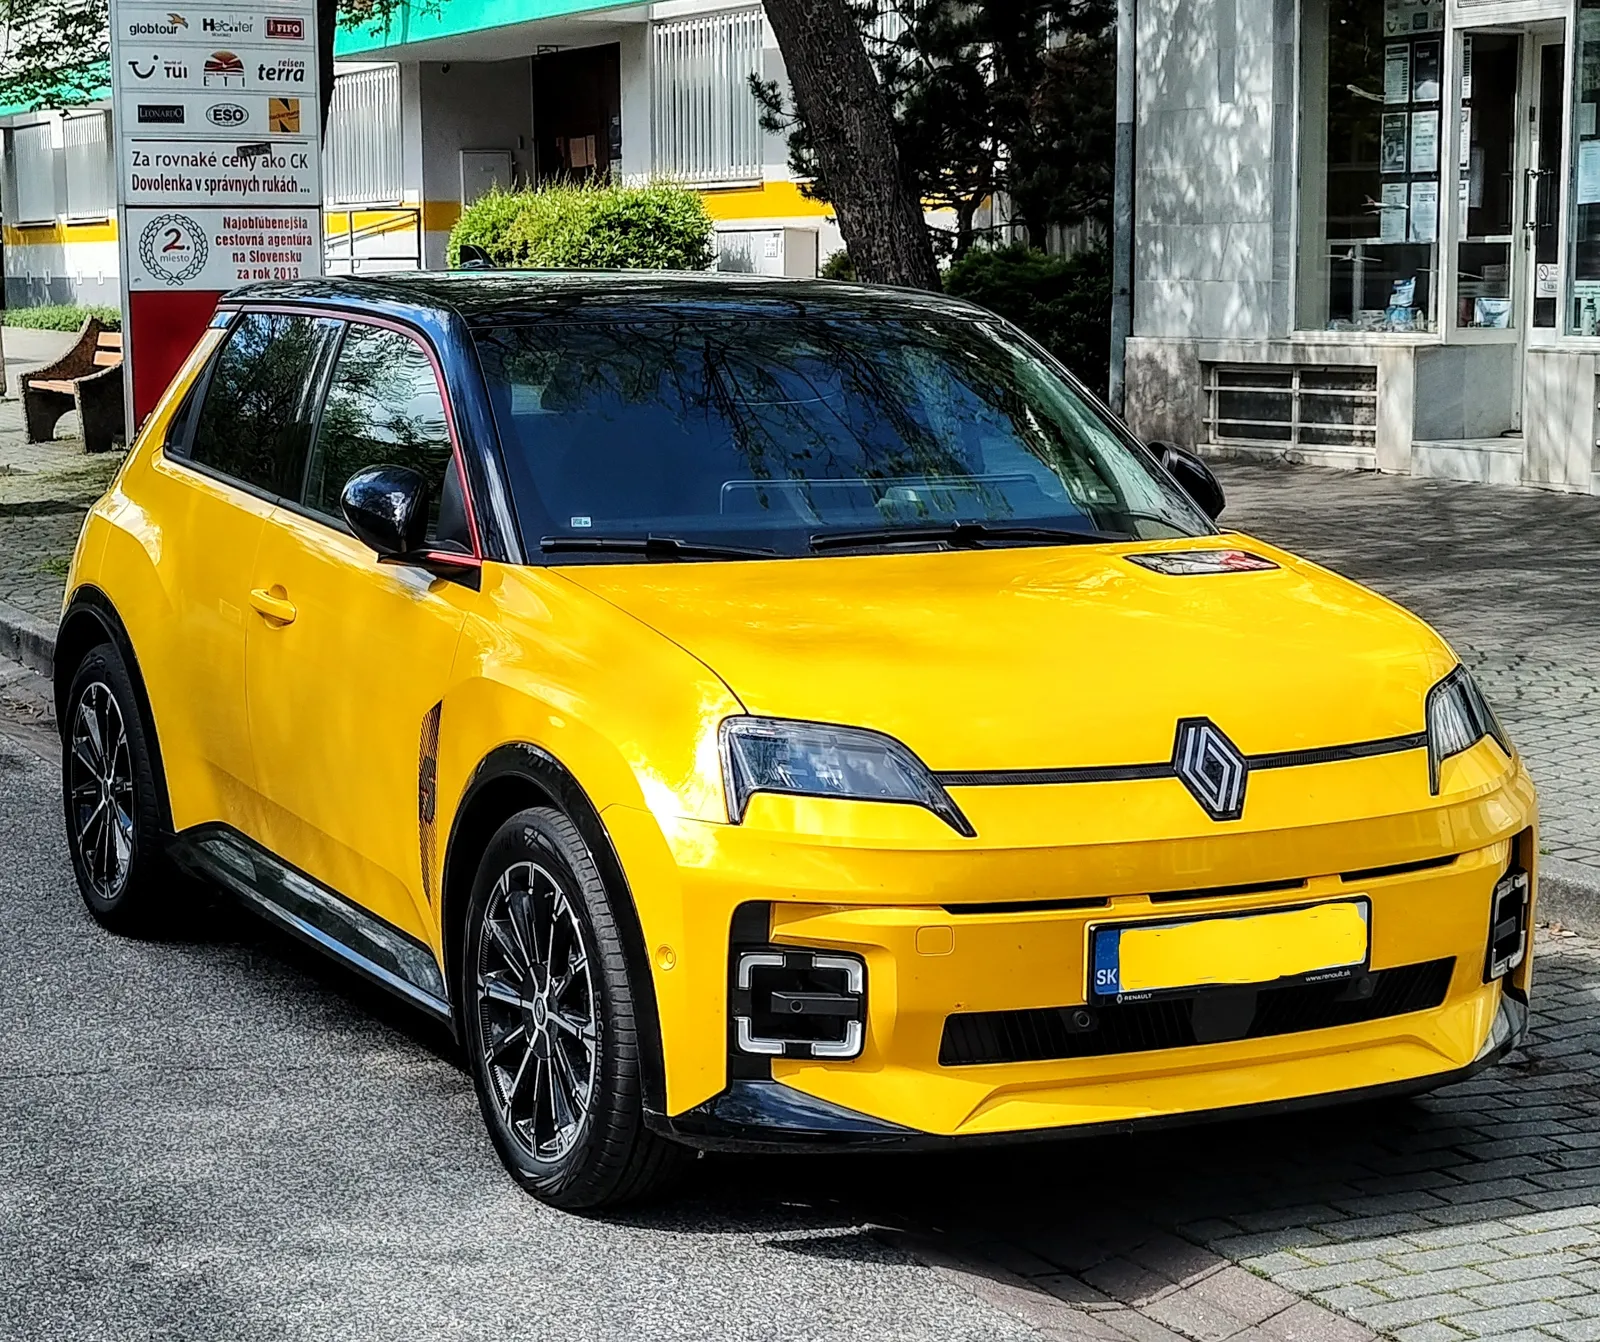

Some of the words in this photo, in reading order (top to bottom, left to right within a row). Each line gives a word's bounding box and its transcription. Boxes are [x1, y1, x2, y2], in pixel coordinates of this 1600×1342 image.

[129, 22, 178, 36] globtour
[202, 15, 254, 33] Hechter
[276, 24, 300, 33] FIFO
[278, 58, 305, 68] reisen
[164, 66, 188, 79] TUI
[258, 63, 305, 82] terra
[213, 108, 244, 121] ESO
[132, 151, 150, 167] Za
[156, 151, 217, 168] rovnaké
[261, 154, 286, 168] ako
[290, 154, 309, 169] CK
[132, 174, 193, 192] Dovolenka
[195, 180, 203, 192] v
[204, 174, 260, 196] správnych
[262, 175, 298, 193] rukách
[222, 216, 308, 231] Najobľúbenejšia
[162, 228, 191, 253] 2.
[215, 233, 264, 246] cestovná
[267, 233, 313, 247] agentúra
[159, 254, 190, 263] miesto
[232, 252, 246, 263] na
[249, 250, 302, 262] Slovensku
[237, 269, 250, 280] za
[253, 267, 270, 280] rok
[273, 267, 299, 280] 2013
[1096, 967, 1118, 986] SK
[1305, 969, 1352, 983] www.renault.sk
[1124, 993, 1152, 1001] RENAULT
[594, 990, 604, 1081] EcoContact
